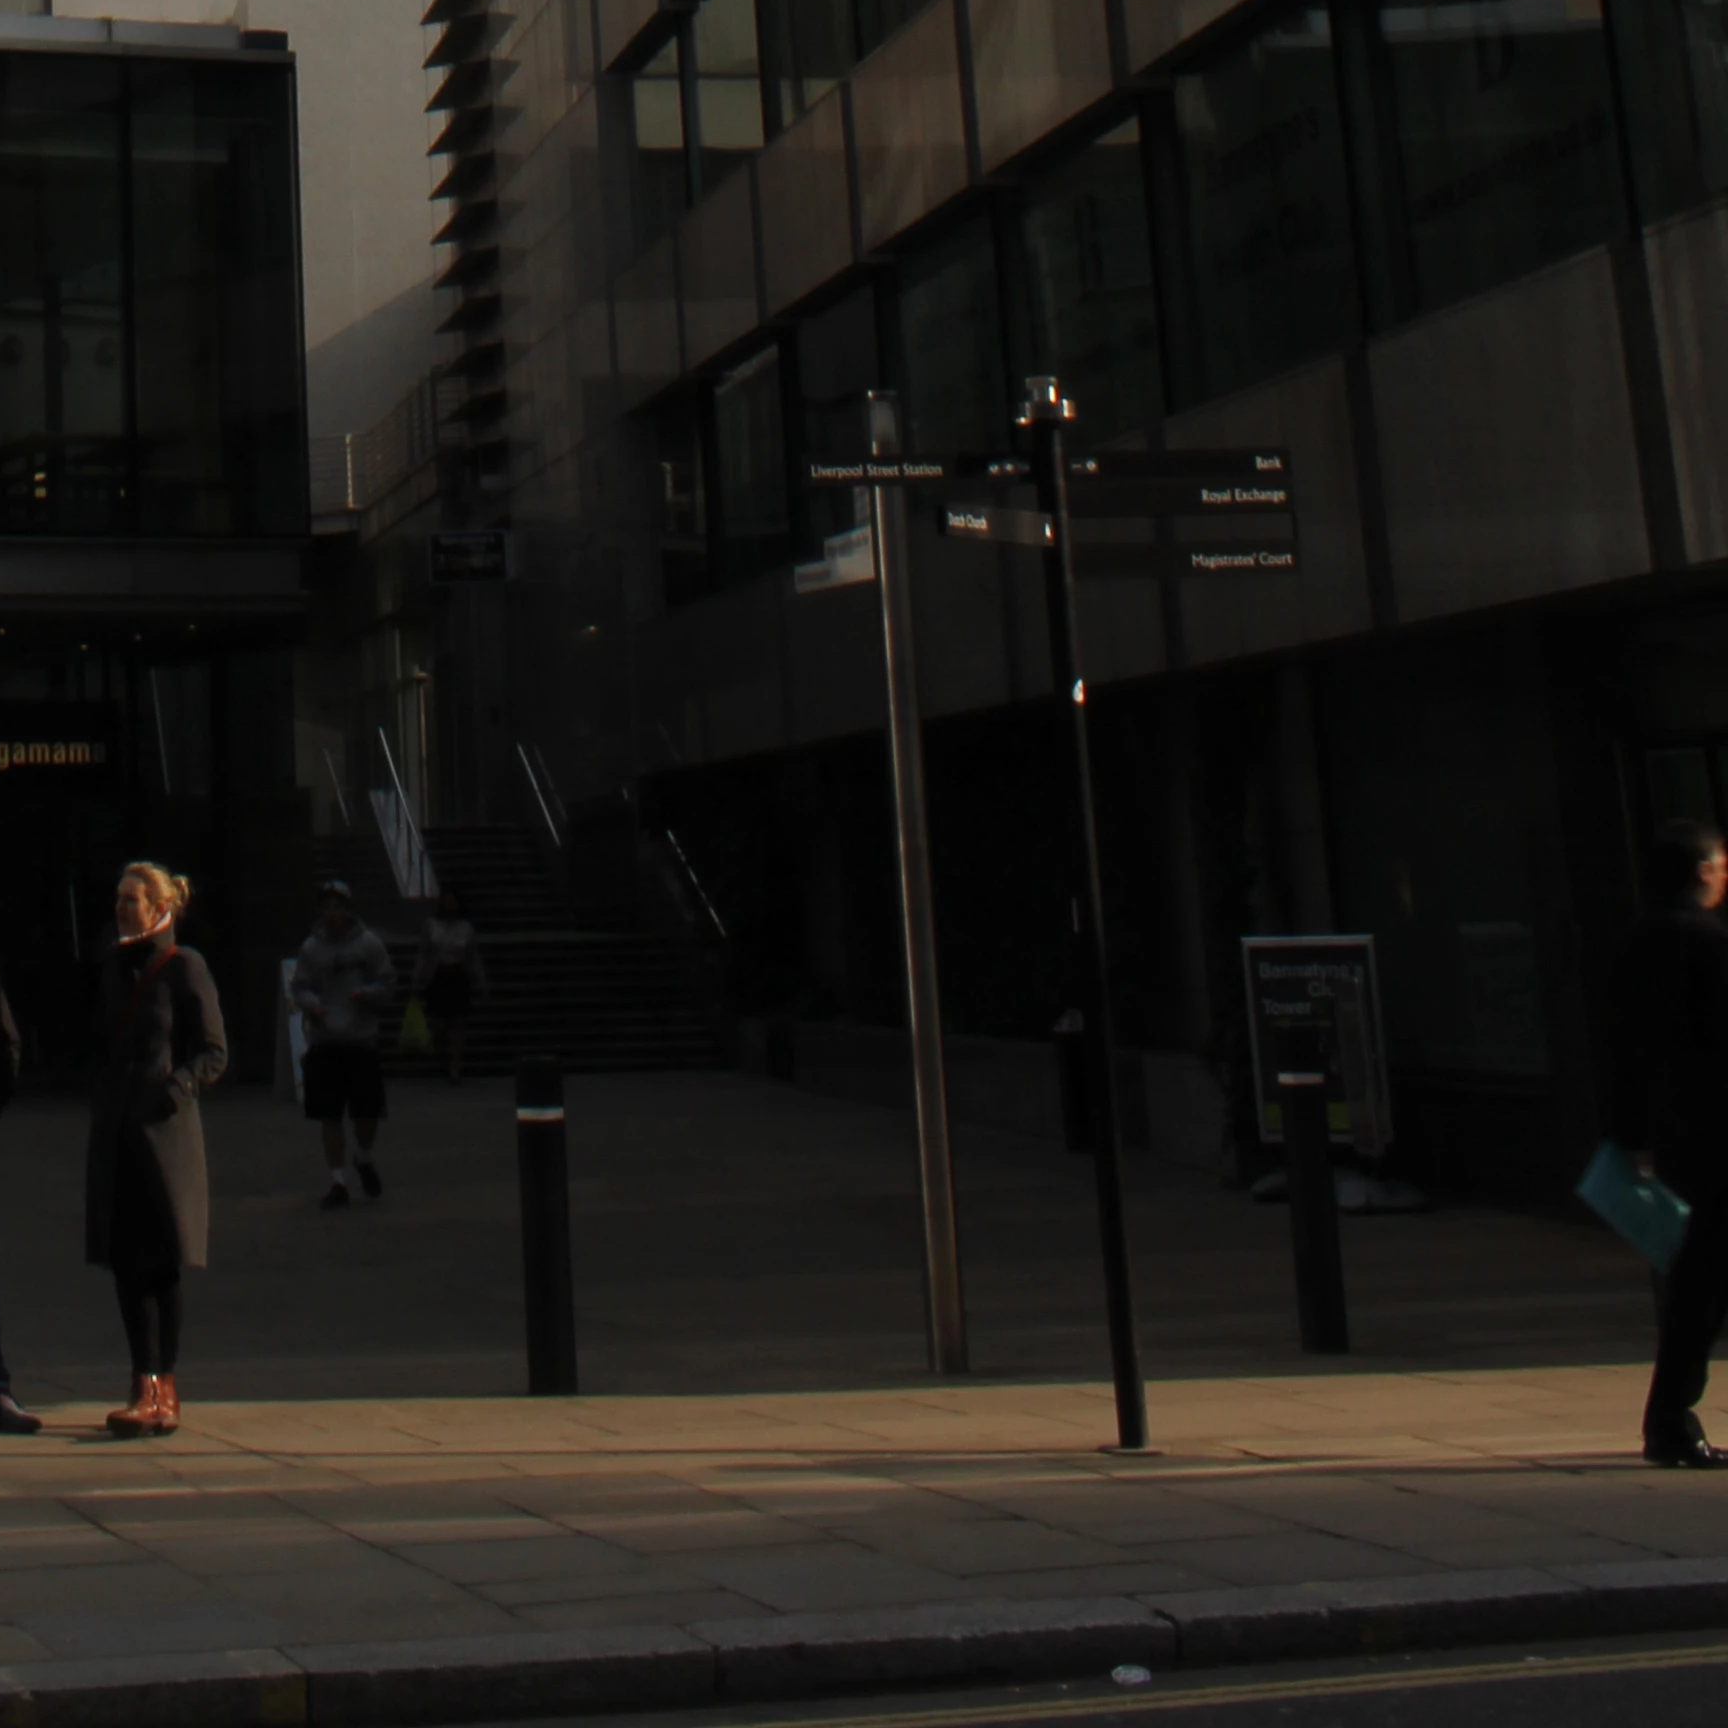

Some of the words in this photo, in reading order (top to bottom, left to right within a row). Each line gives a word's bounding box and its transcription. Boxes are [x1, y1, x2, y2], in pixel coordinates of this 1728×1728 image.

[810, 462, 863, 479] Liverpool
[866, 461, 899, 477] Street
[902, 461, 943, 477] Station
[1255, 455, 1283, 471] Bank
[1201, 488, 1231, 505] Royal
[1235, 487, 1287, 504] Exchange
[1192, 551, 1256, 569] Magistrates'
[1259, 551, 1293, 567] Court
[1261, 997, 1312, 1015] Tower
